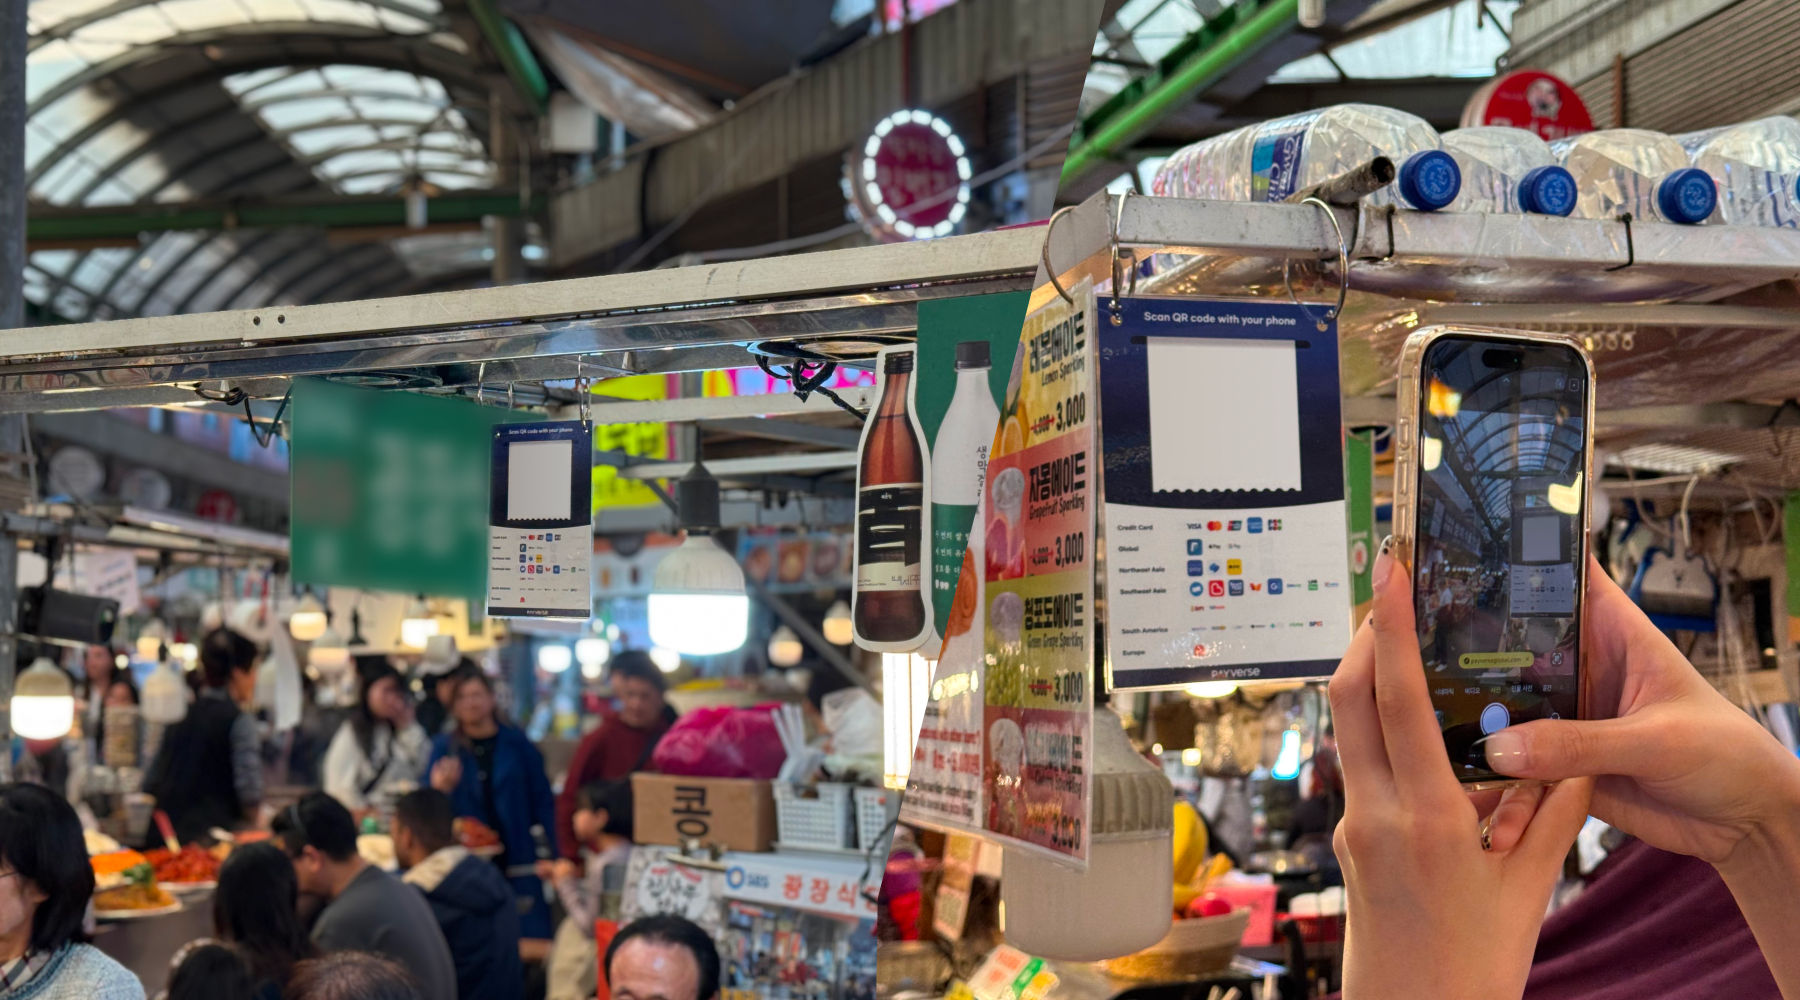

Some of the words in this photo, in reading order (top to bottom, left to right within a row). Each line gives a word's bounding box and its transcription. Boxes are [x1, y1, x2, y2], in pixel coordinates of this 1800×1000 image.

[1144, 312, 1170, 322] Scan
[1172, 313, 1188, 323] QR
[1190, 314, 1216, 324] code
[1218, 315, 1239, 324] with
[1241, 317, 1263, 327] your
[1265, 316, 1296, 327] phone
[1030, 311, 1085, 374] 레몬에이드
[1042, 369, 1058, 386] Lemon
[1060, 355, 1084, 382] Sparkling
[1056, 392, 1086, 432] 3,000
[1029, 451, 1086, 502] 자몽에이드
[1030, 500, 1058, 522] Grapefruit
[1059, 494, 1085, 517] Sparkling
[1055, 531, 1084, 568] 3,000
[1025, 593, 1083, 630] 청포도에이드
[1028, 633, 1041, 648] Green
[1042, 633, 1058, 653] Grape
[1060, 631, 1083, 652] Sparkling
[1054, 671, 1083, 704] 3,000
[672, 786, 712, 837] 콩
